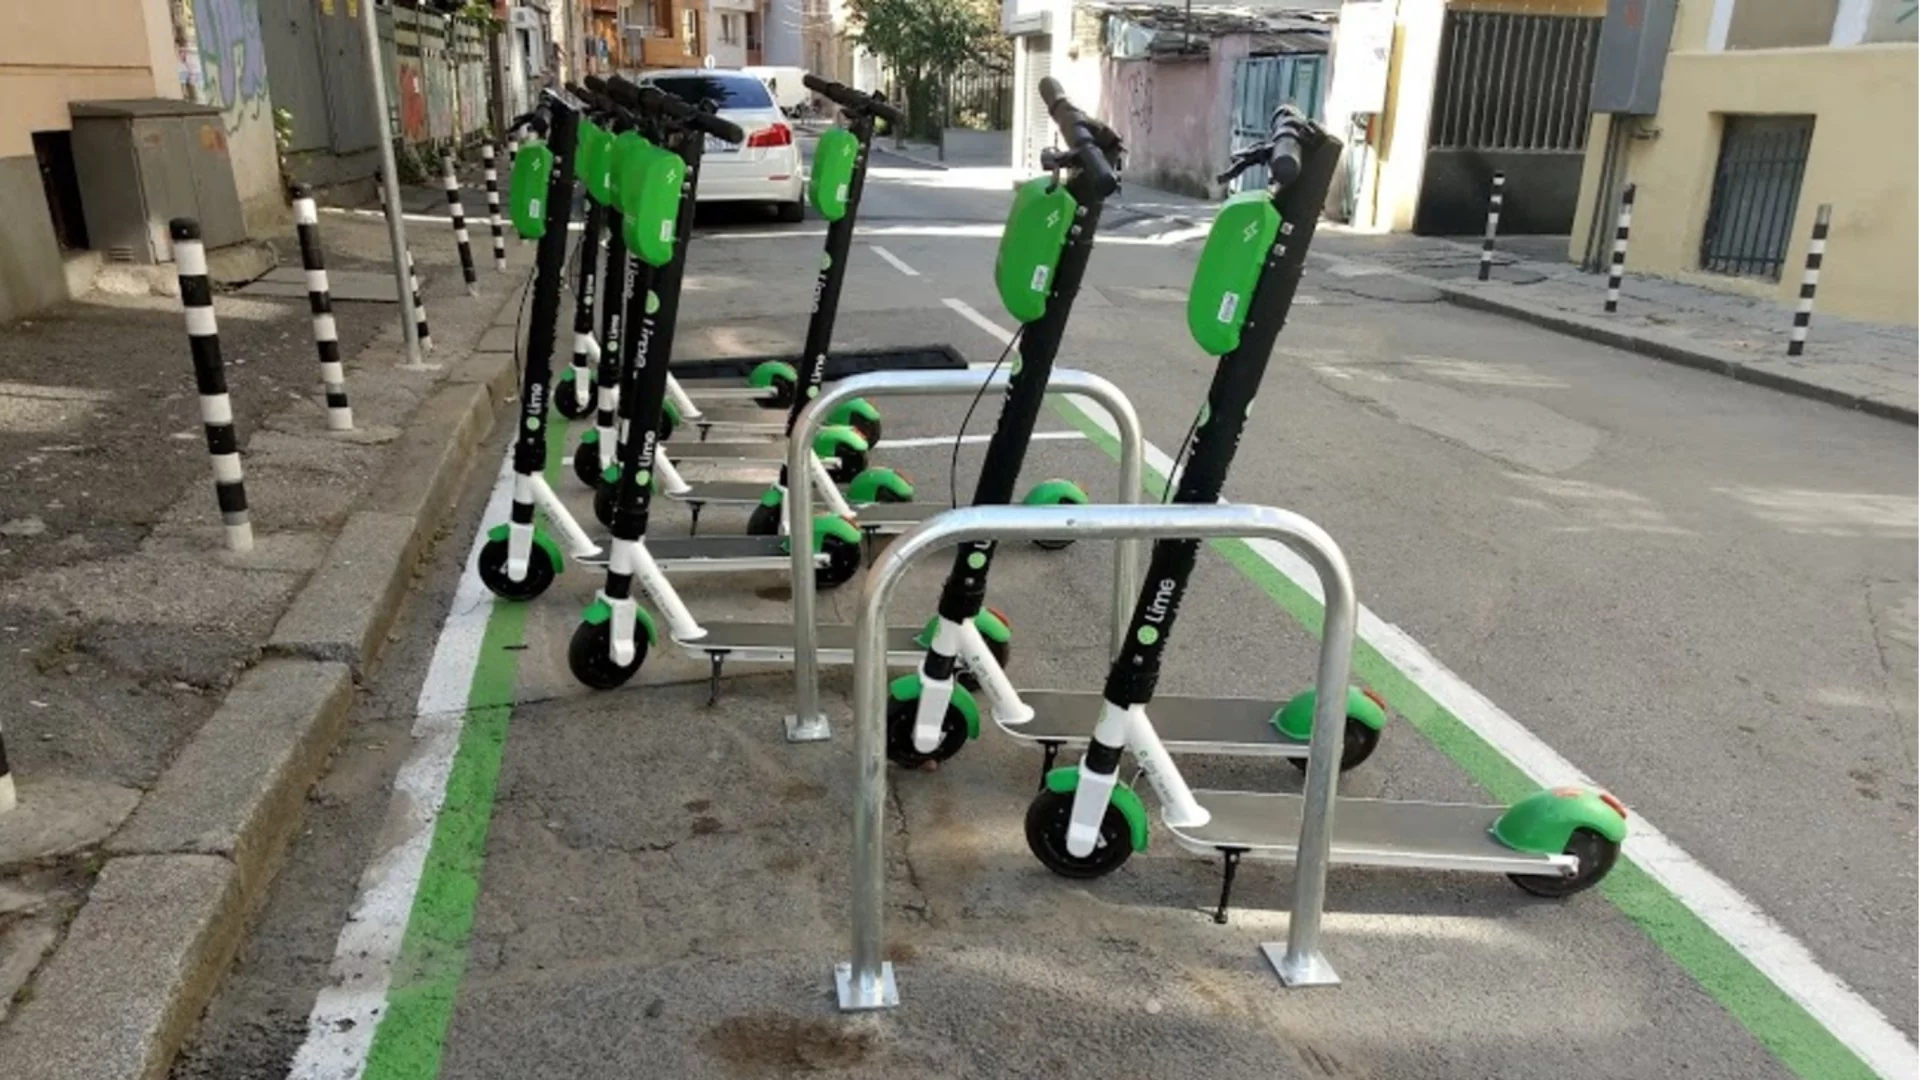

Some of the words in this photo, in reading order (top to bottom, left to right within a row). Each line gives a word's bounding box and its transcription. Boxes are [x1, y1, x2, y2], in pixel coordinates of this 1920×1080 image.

[526, 383, 542, 415] Lime
[638, 430, 655, 467] Lime
[1144, 578, 1176, 623] Lime
